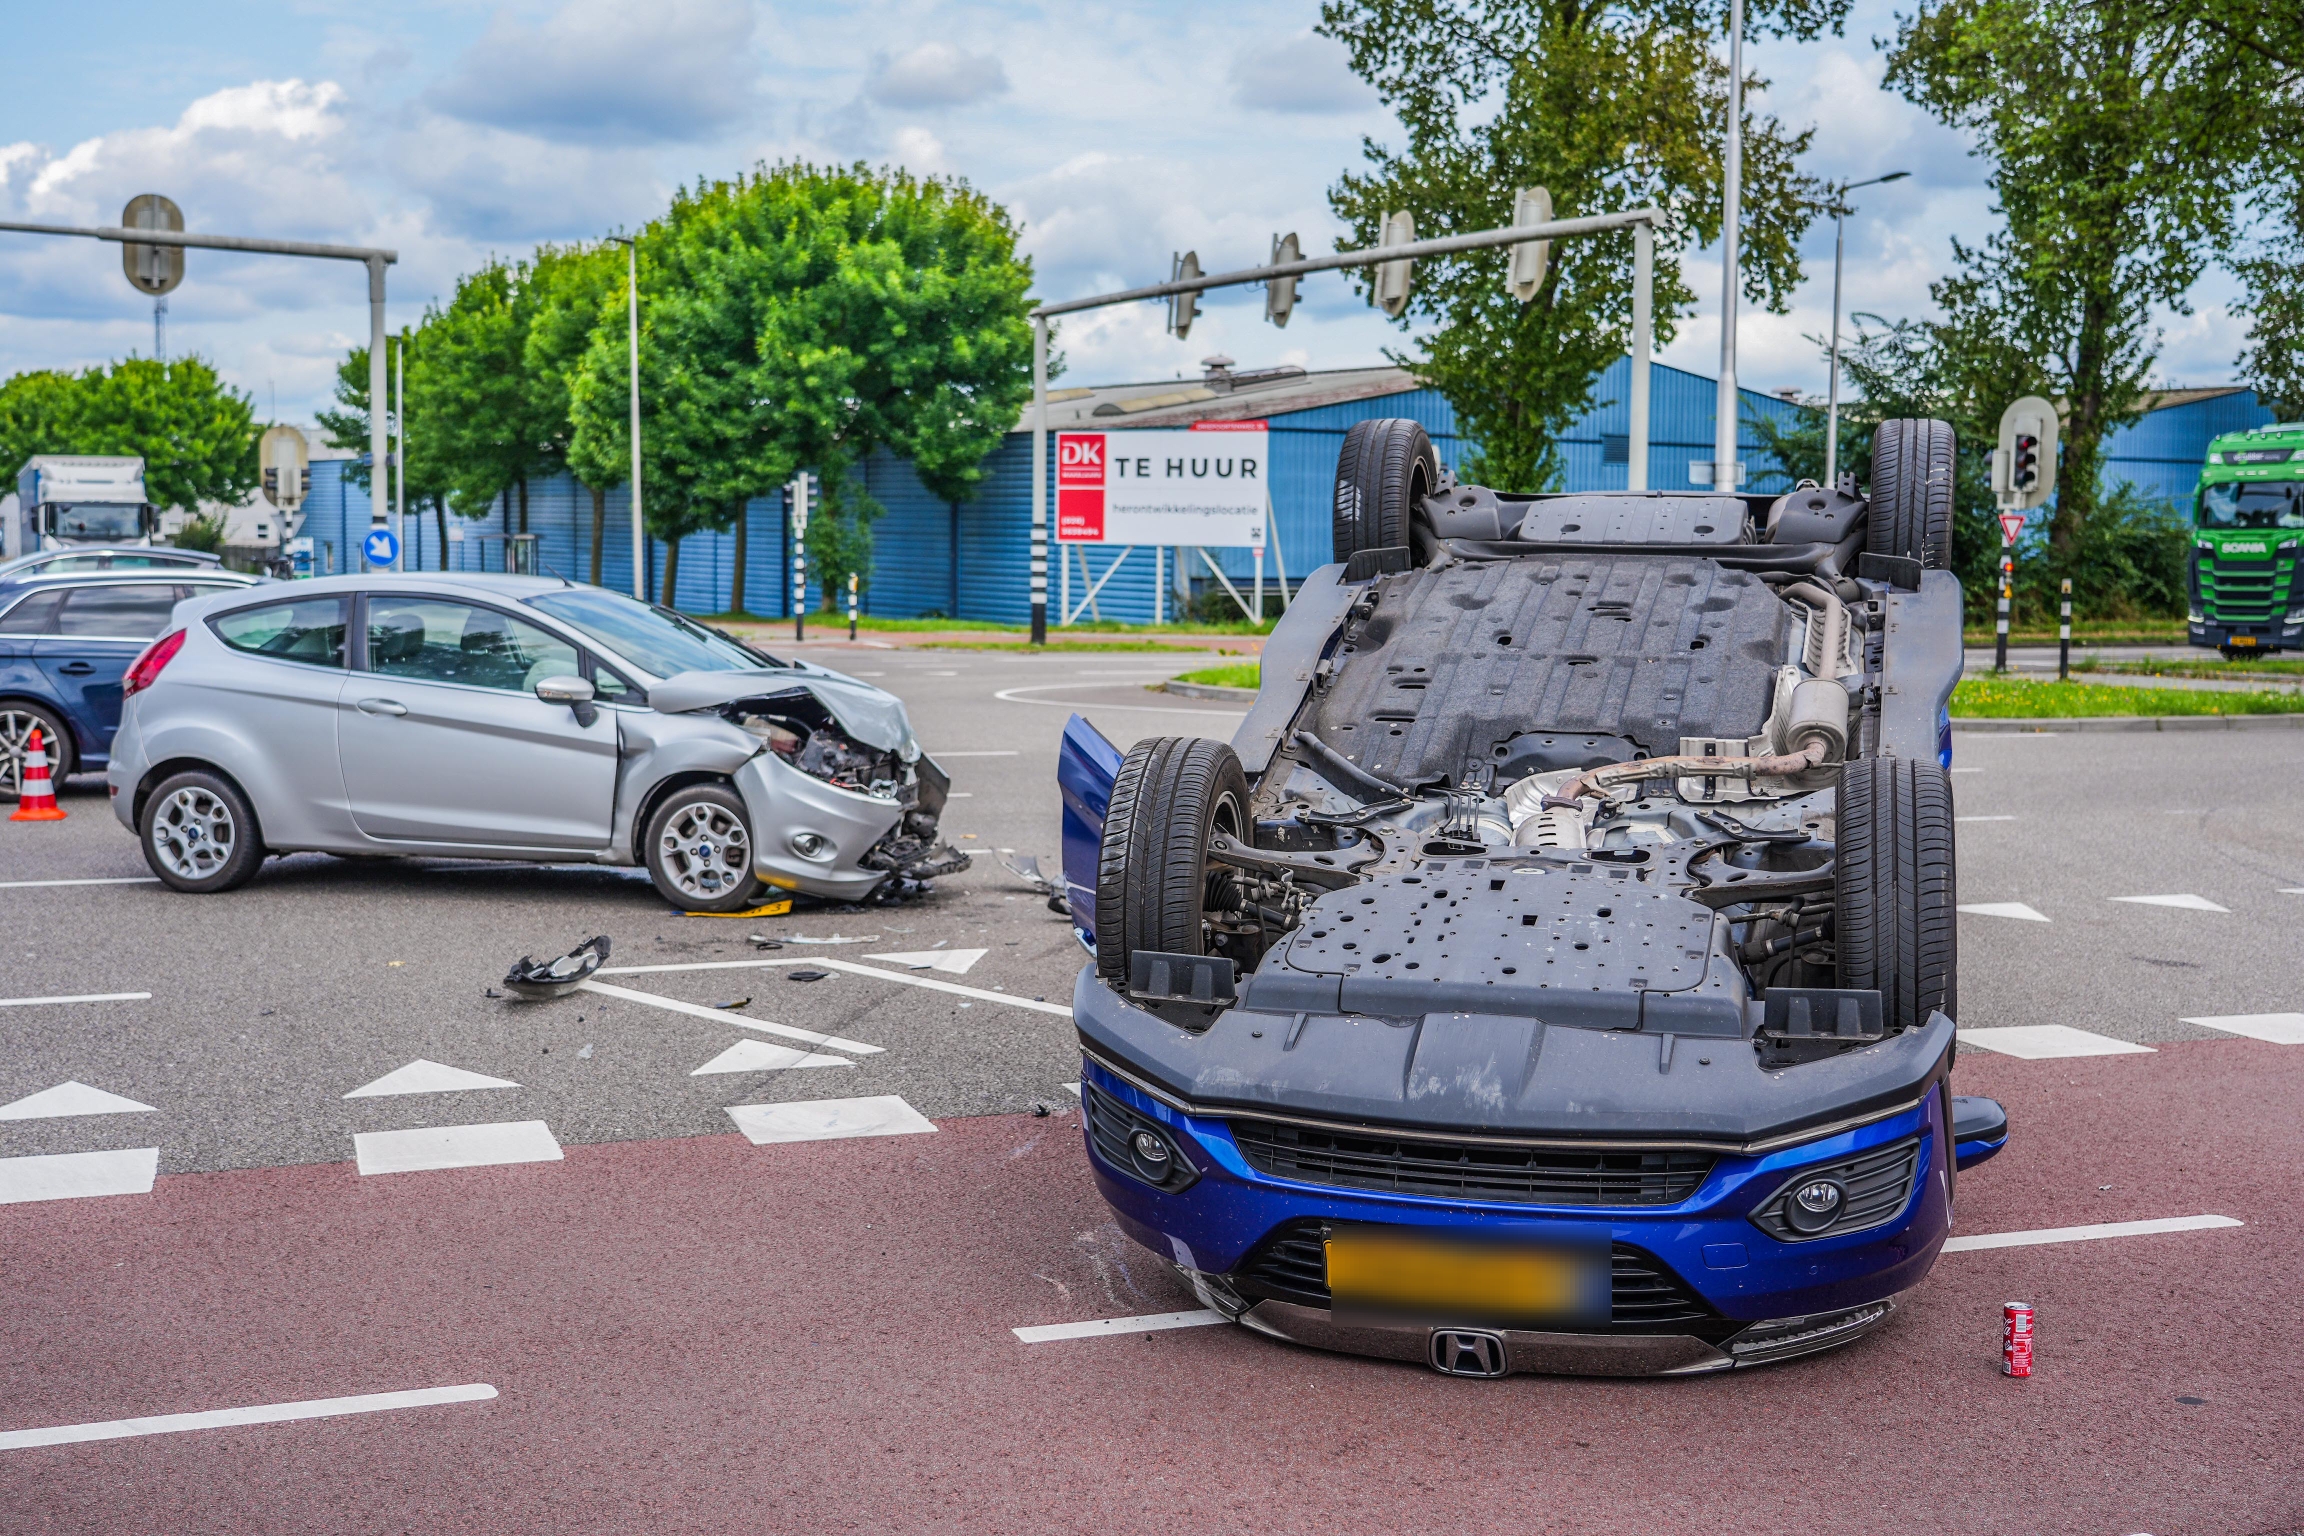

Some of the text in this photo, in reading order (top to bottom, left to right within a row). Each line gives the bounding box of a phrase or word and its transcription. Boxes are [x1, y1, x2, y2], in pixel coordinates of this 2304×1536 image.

[1061, 442, 1102, 465] DK
[1115, 458, 1257, 478] TE HUUR
[1112, 503, 1258, 517] herontwikkelingslocatie
[2221, 541, 2267, 553] SCANIA
